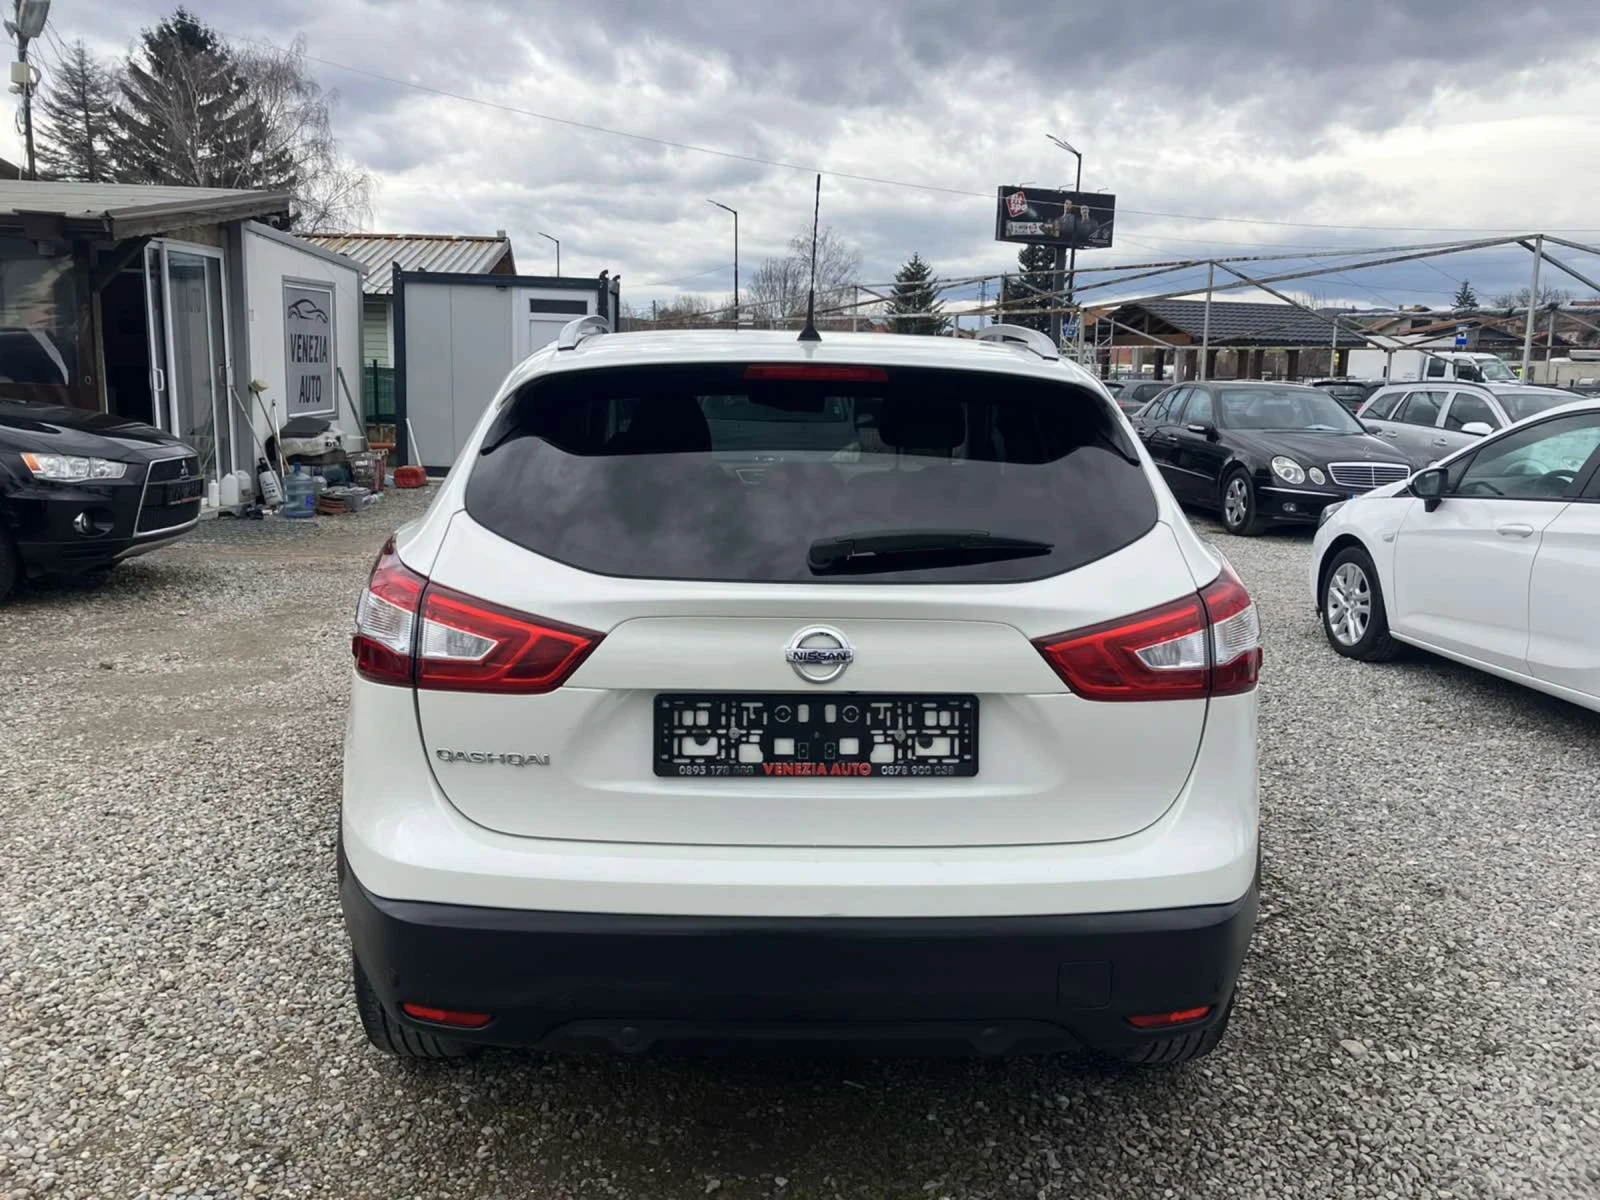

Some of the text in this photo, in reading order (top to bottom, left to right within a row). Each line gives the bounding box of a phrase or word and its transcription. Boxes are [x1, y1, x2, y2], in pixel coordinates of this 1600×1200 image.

[290, 333, 328, 363] VENEZIA
[299, 375, 322, 403] AUTO
[793, 651, 847, 661] NISSAN
[436, 748, 551, 768] QASHQAI
[762, 762, 827, 776] VENEZIA
[830, 762, 872, 776] AUTO
